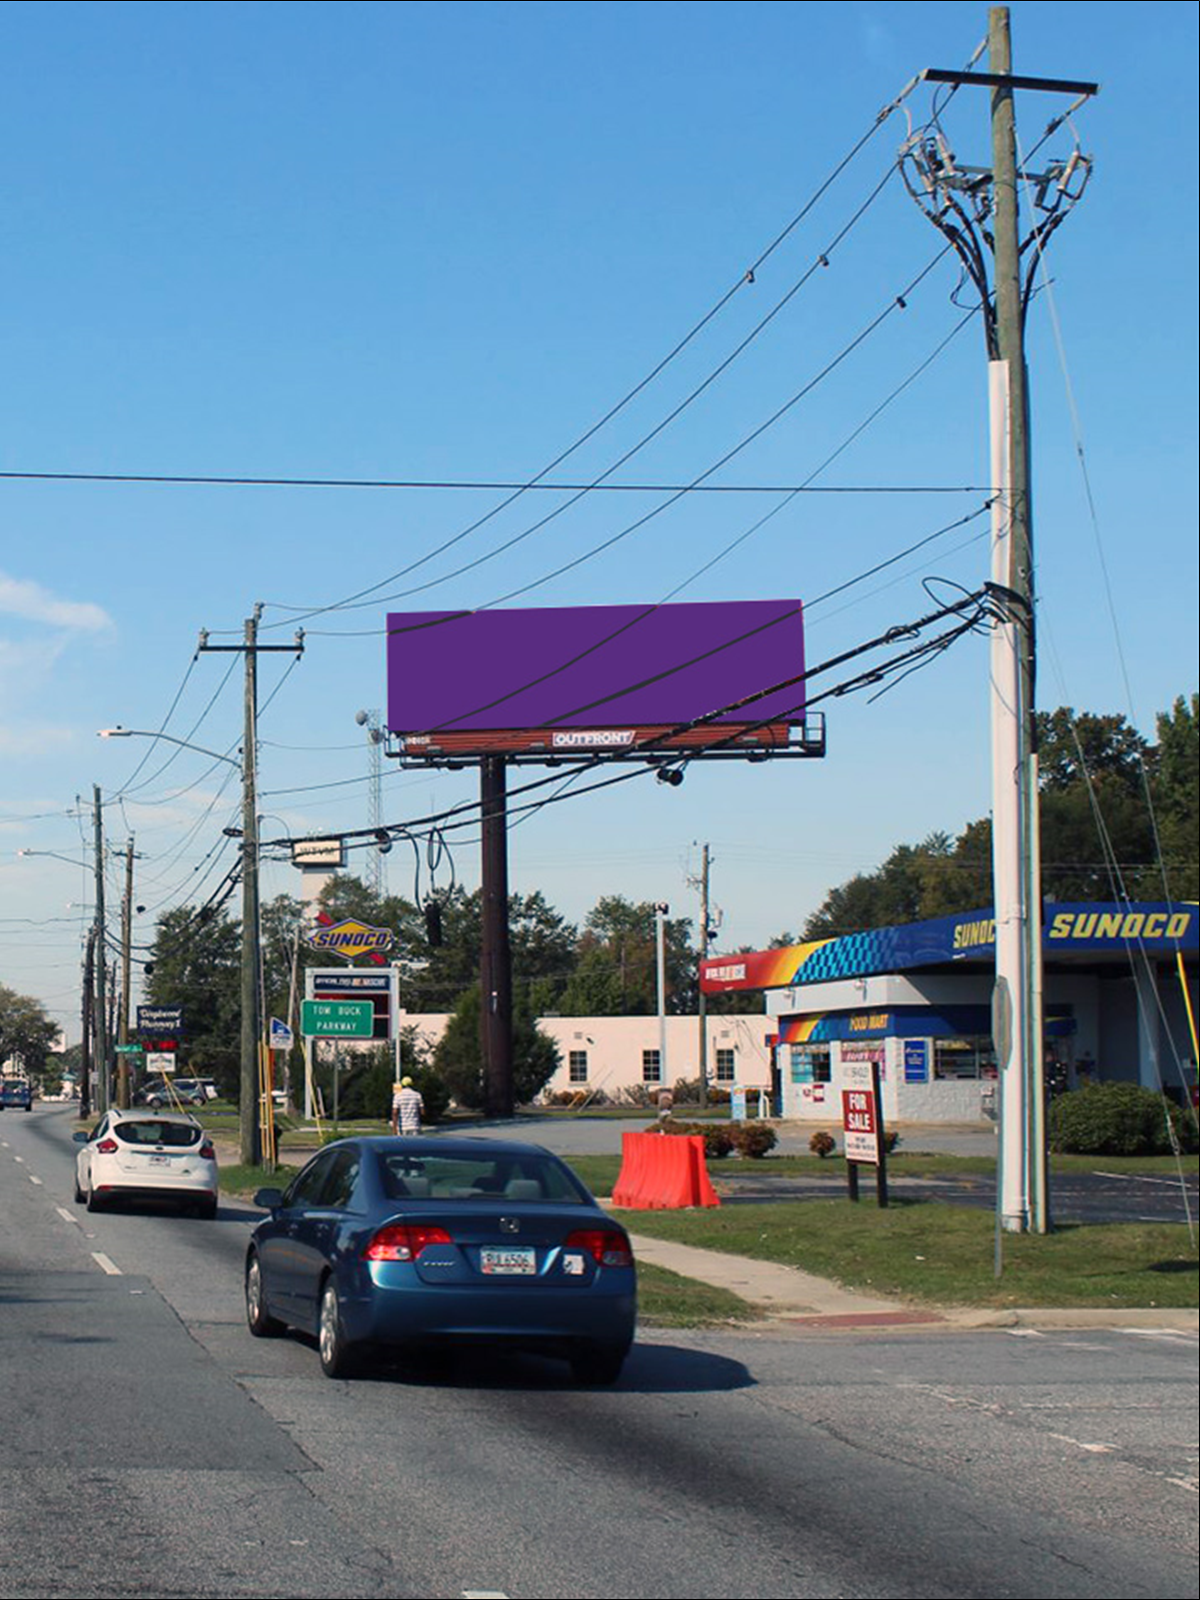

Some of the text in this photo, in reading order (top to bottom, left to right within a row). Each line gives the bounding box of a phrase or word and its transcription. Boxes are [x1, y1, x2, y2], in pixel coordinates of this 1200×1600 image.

[556, 732, 632, 746] OUTFRONT
[1049, 913, 1191, 938] SUNOCO
[317, 933, 388, 946] SUNOCO
[953, 919, 996, 949] SUNOC
[313, 1005, 331, 1015] TOM
[316, 1021, 357, 1031] PARKWAY
[849, 1092, 867, 1110] FOR
[848, 1112, 871, 1130] SALE
